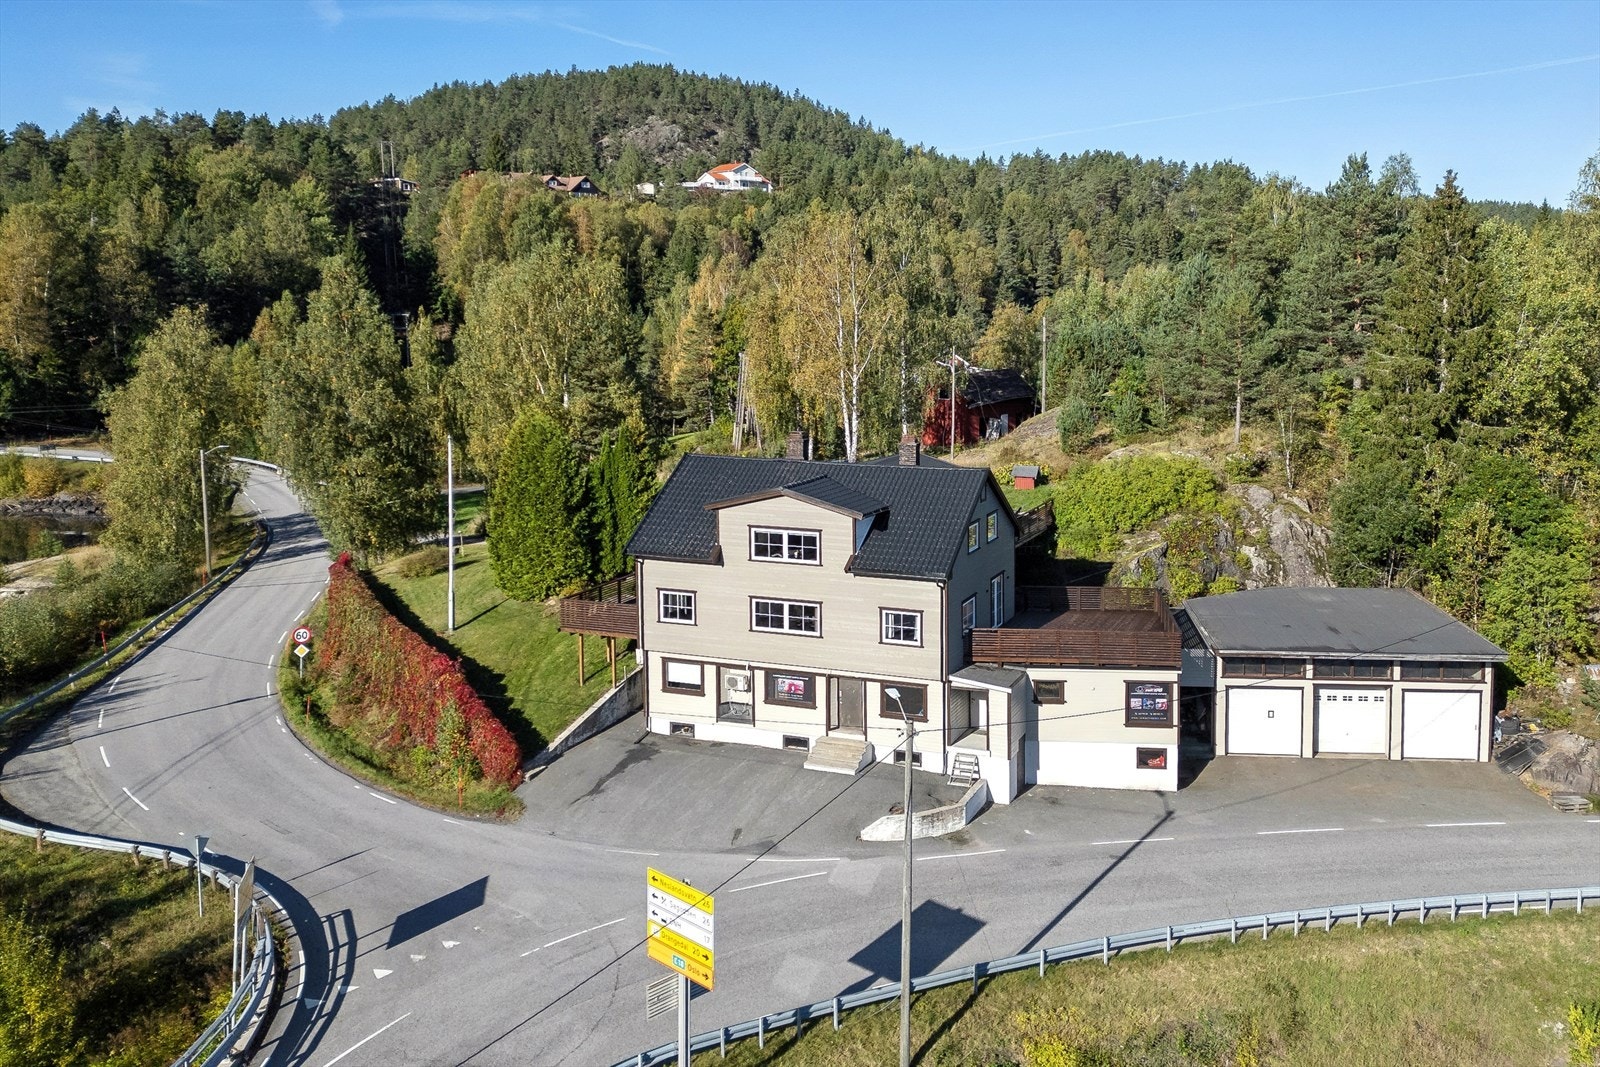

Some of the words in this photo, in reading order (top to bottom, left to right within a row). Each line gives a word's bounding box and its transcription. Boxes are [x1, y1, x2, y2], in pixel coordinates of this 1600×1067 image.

[296, 631, 308, 640] 60
[661, 930, 689, 950] Drangedal
[692, 947, 700, 957] 20
[687, 964, 700, 976] Oslo
